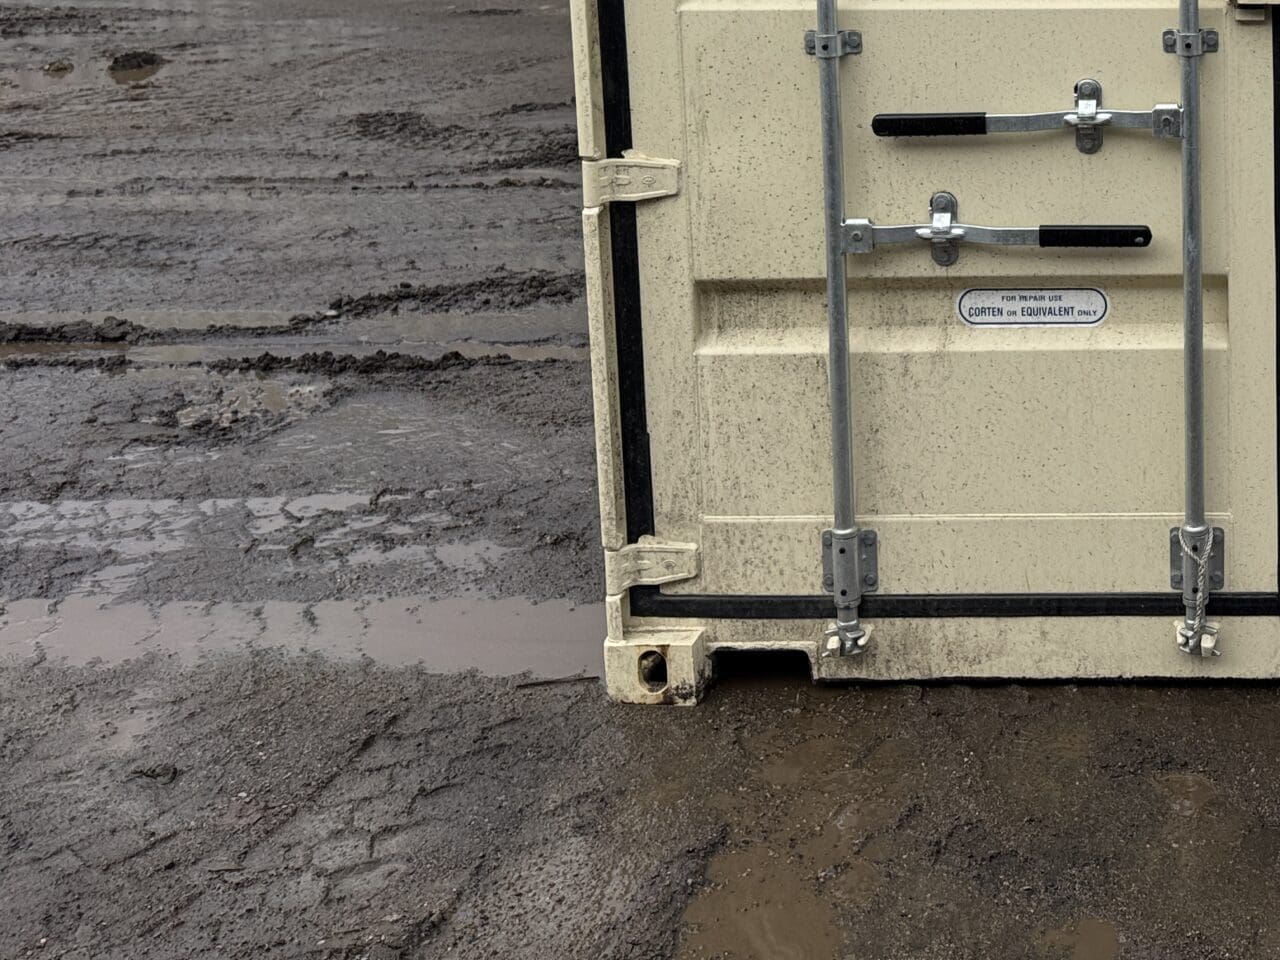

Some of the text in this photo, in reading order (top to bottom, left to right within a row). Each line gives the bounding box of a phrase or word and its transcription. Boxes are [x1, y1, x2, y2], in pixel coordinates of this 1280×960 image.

[968, 306, 1098, 318] CORTEN OR EQUIVALENT ONLY
